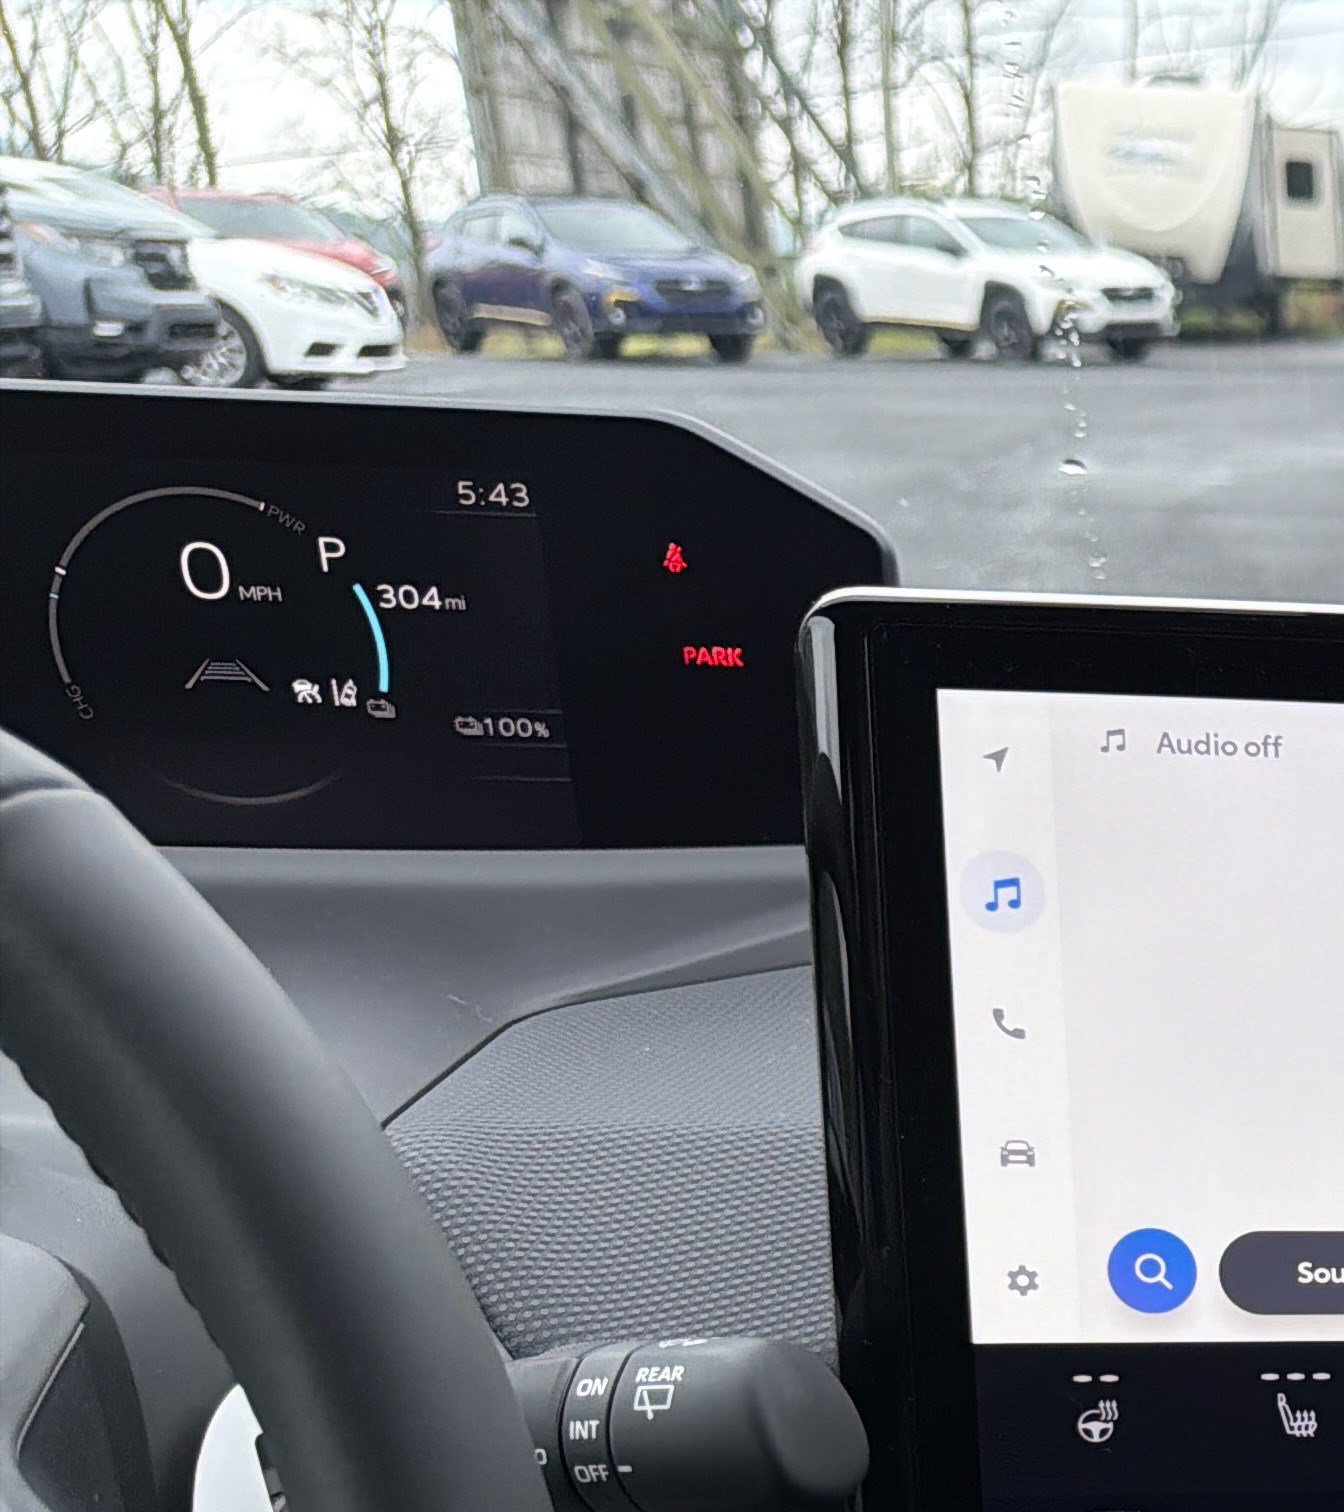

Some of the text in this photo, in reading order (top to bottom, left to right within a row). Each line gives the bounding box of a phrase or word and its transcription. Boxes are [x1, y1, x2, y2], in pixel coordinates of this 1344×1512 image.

[457, 480, 530, 507] 5:43
[267, 504, 306, 533] PWR
[317, 536, 346, 572] P
[180, 541, 283, 602] 0 MPH
[682, 646, 745, 667] PARK
[65, 684, 95, 720] CHG
[482, 717, 551, 738] 100%
[1157, 731, 1284, 759] Audio off
[635, 1365, 685, 1383] REAR
[576, 1377, 609, 1397] ON
[569, 1420, 600, 1440] INT
[574, 1464, 609, 1483] OFF
